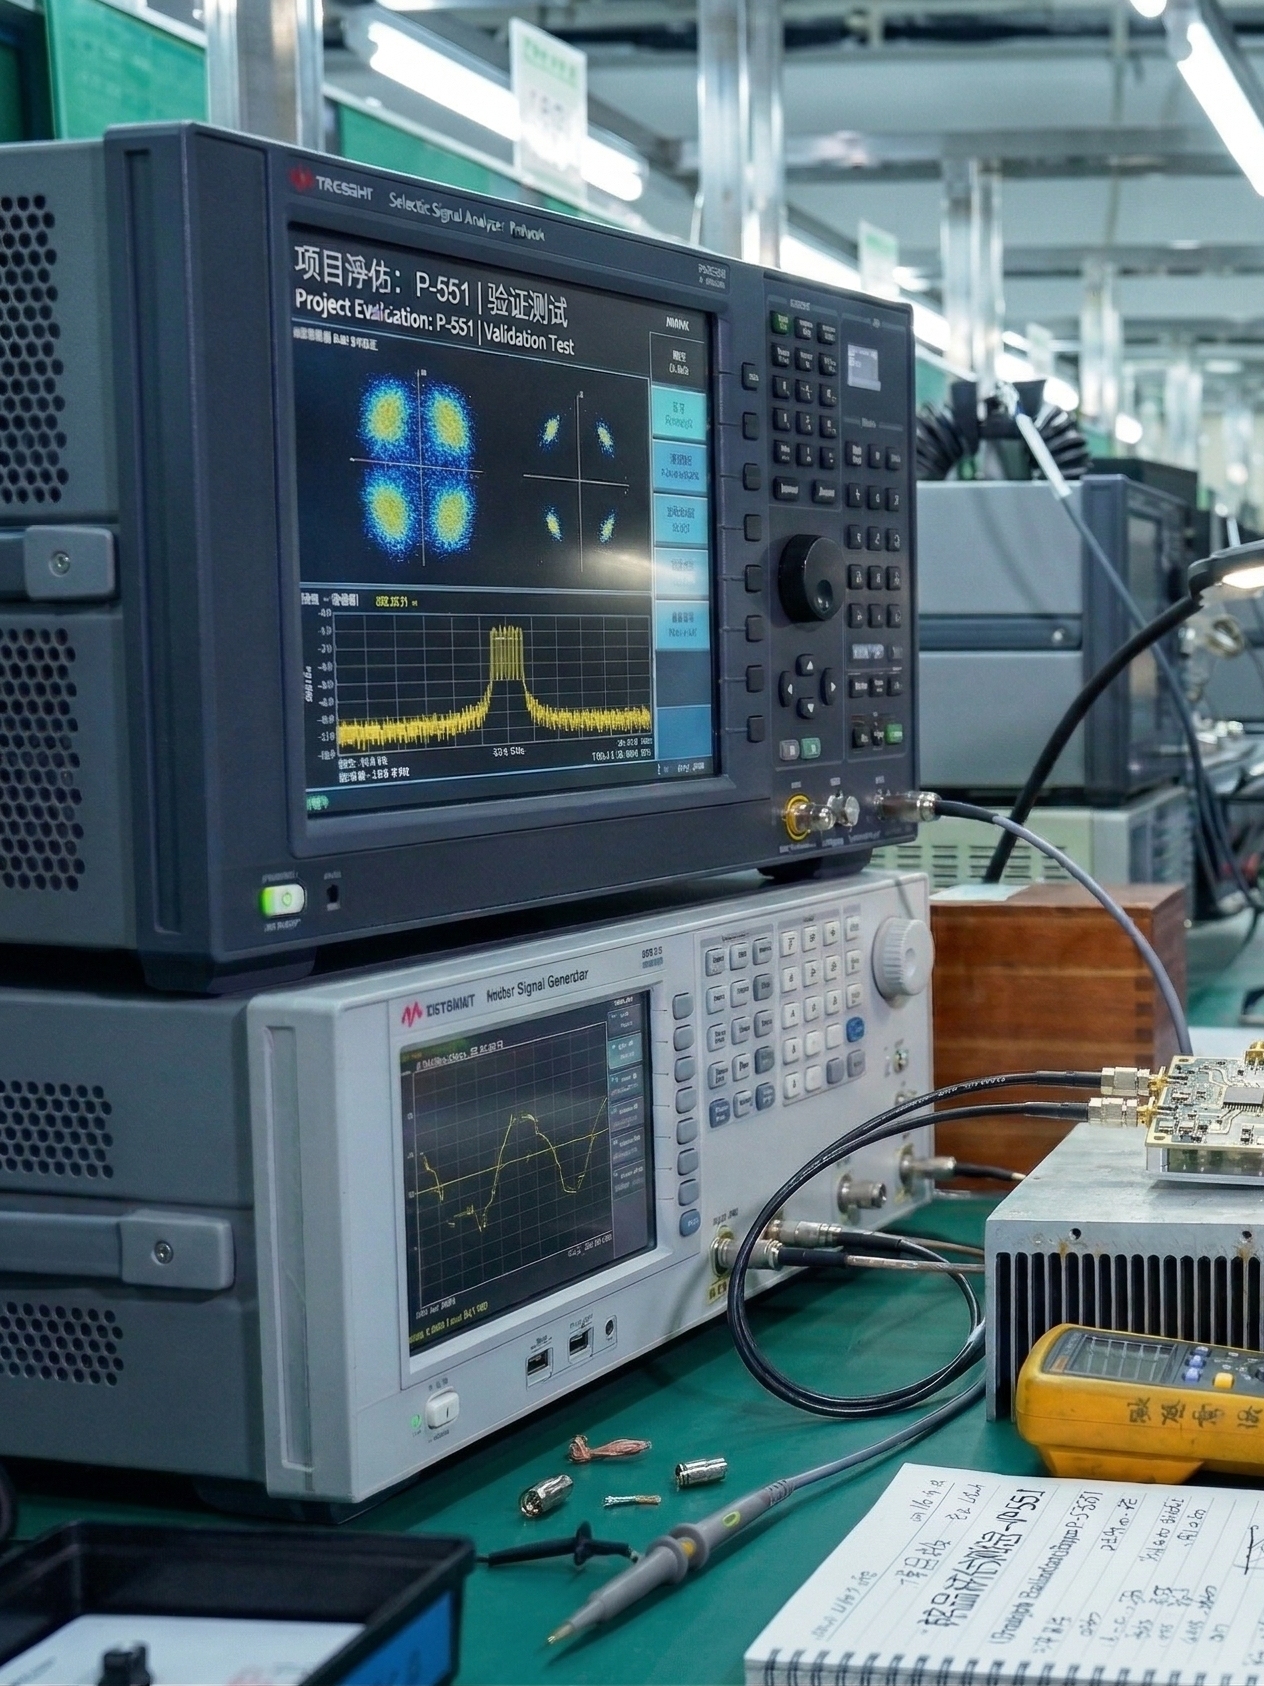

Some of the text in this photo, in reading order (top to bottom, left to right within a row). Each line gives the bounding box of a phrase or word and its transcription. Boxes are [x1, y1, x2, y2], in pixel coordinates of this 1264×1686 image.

[295, 288, 352, 318] Project
[436, 314, 474, 338] P-551
[484, 321, 547, 351] Validation
[547, 333, 575, 356] Test
[415, 271, 470, 307] P-551
[487, 282, 569, 328] 验证测试
[517, 977, 546, 997] Signal
